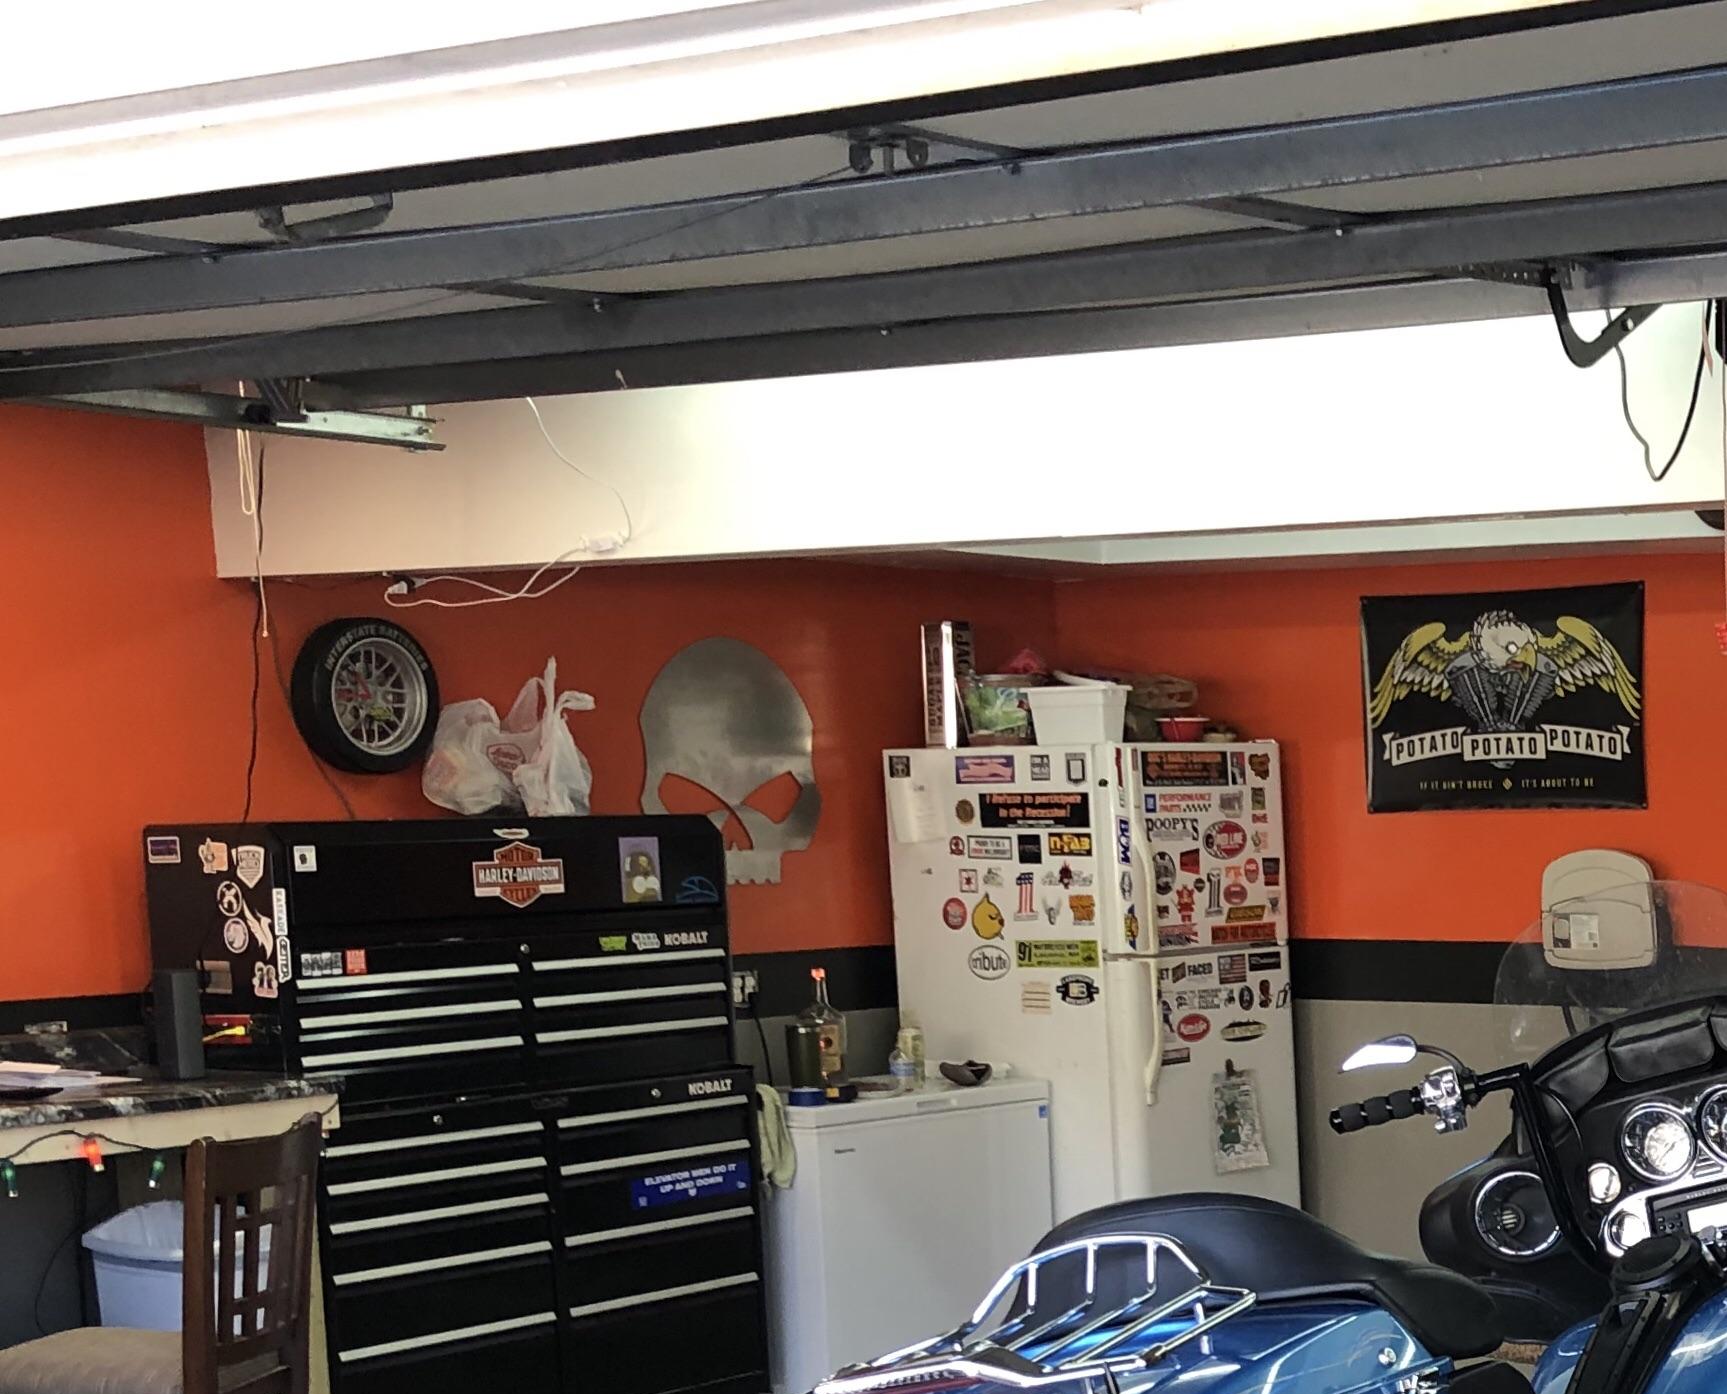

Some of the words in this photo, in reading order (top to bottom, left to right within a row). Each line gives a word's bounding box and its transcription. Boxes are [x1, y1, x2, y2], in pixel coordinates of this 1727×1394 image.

[1396, 730, 1459, 761] POTATO
[1471, 736, 1538, 757] POTATO
[1550, 728, 1617, 755] POTATO
[1541, 778, 1567, 788] ABOUT
[1570, 777, 1580, 787] TO
[1160, 793, 1212, 802] PERFORMANCE
[1160, 804, 1182, 813] PARTS
[1145, 818, 1199, 842] POOPY'S
[478, 866, 559, 884] HARLEY-DAVIDSON
[663, 931, 708, 947] KOBALT
[1188, 962, 1213, 976] FACED
[687, 1079, 733, 1096] KOBALT
[644, 1170, 690, 1187] ELEVATOR
[691, 1166, 712, 1178] MEN
[712, 1164, 727, 1174] DO
[728, 1162, 737, 1172] IT
[660, 1183, 674, 1194] UP
[675, 1180, 695, 1191] AND
[696, 1175, 724, 1187] DOWN
